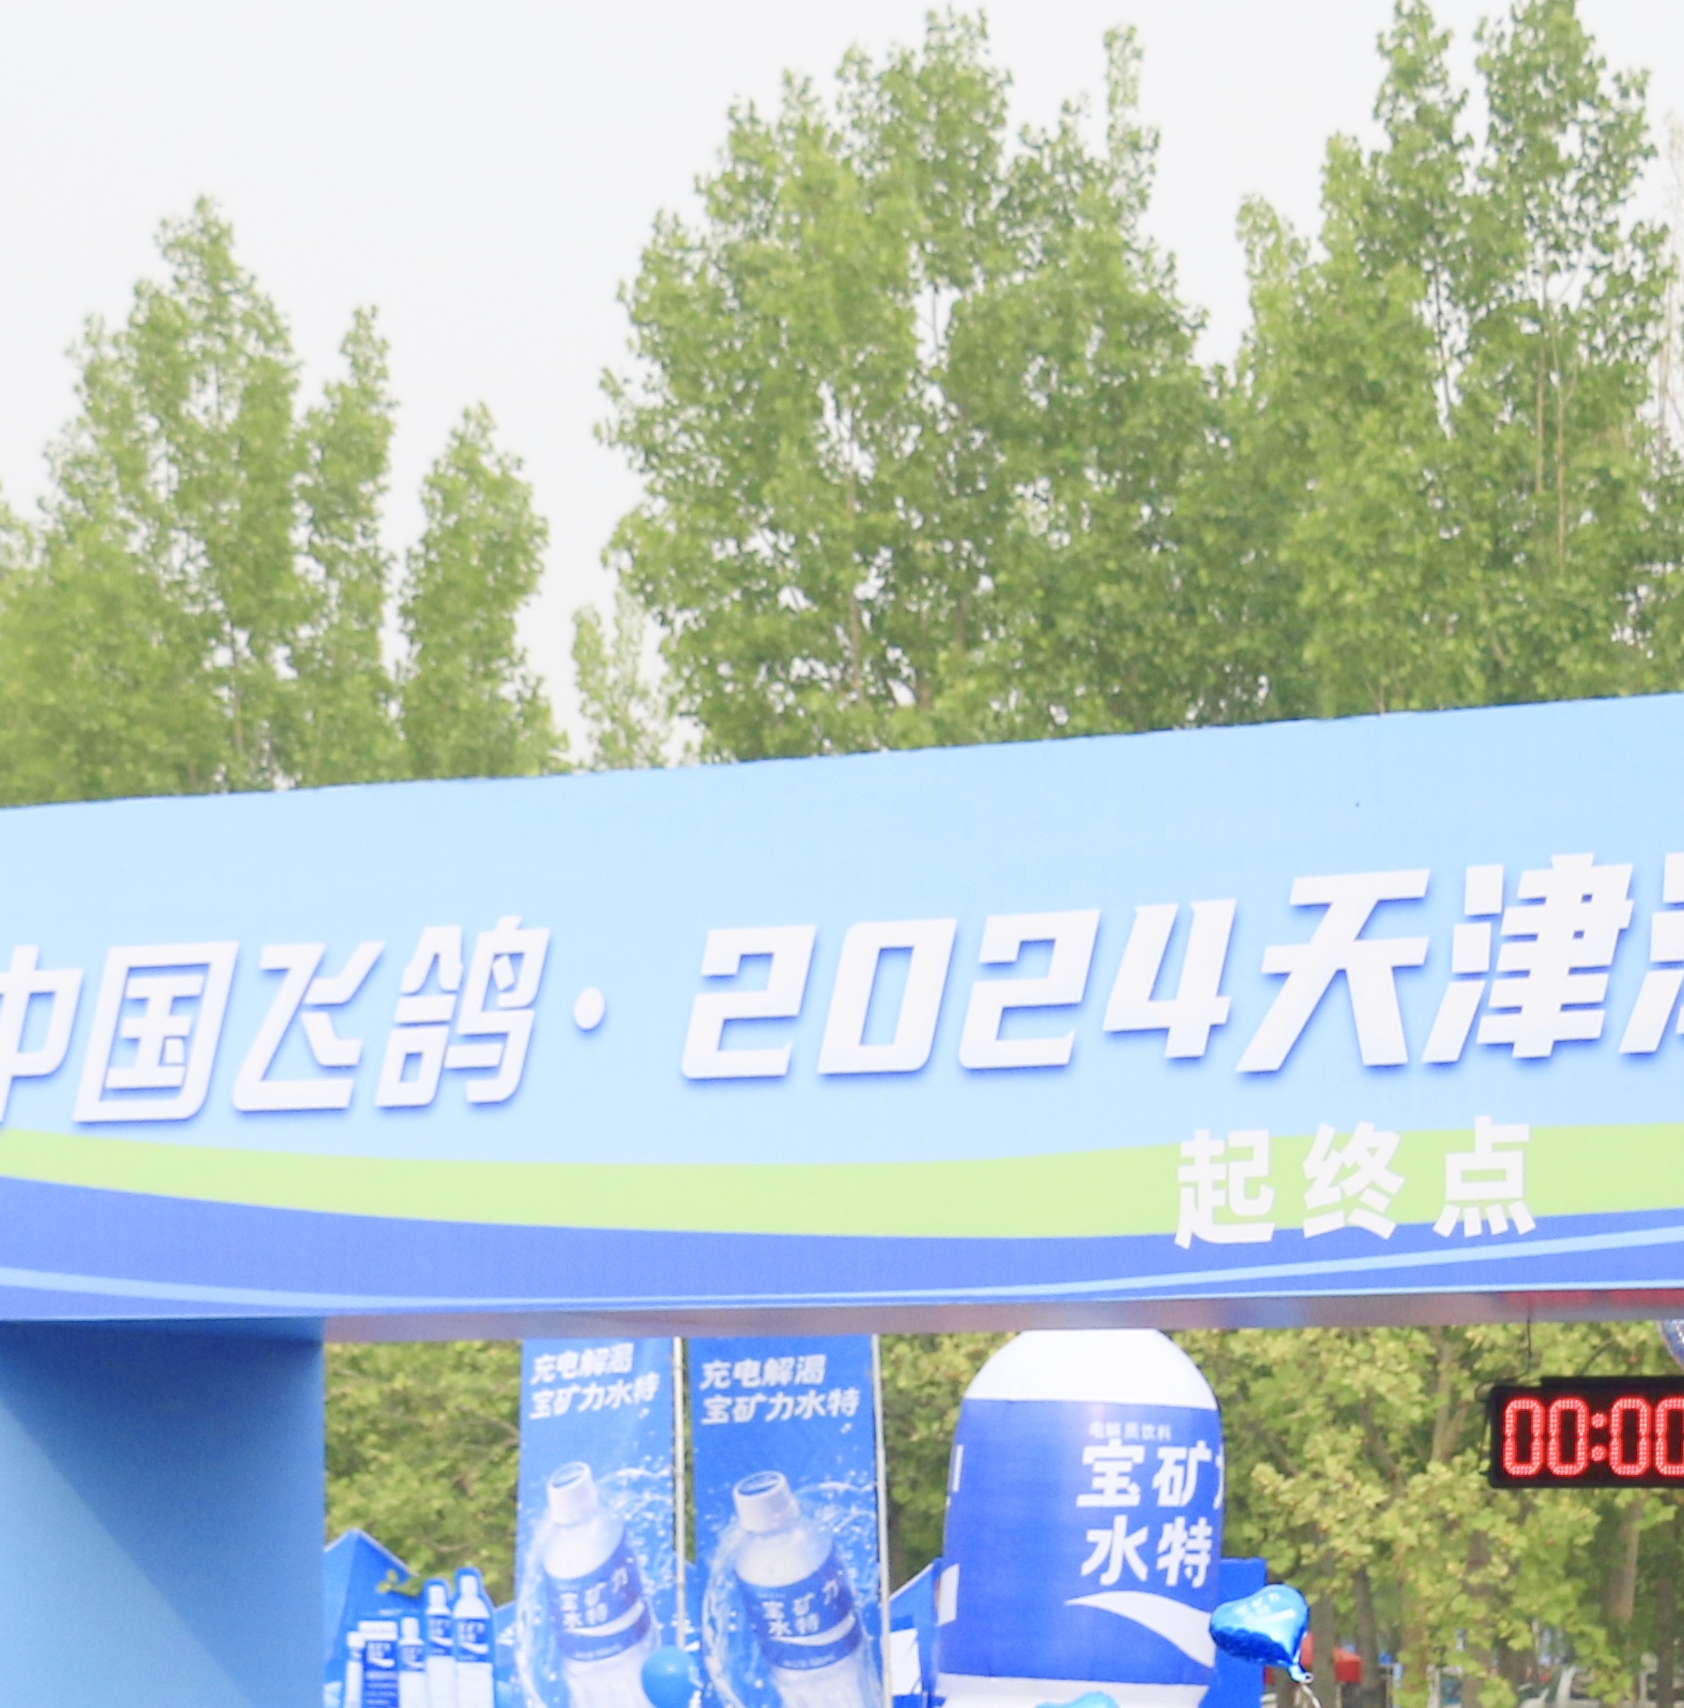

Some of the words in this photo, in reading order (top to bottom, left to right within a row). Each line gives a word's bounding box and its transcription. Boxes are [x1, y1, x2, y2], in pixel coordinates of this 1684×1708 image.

[1175, 1117, 1537, 1250] 起终点
[530, 1341, 634, 1385] 充电解渴
[699, 1353, 827, 1390] 充电解渴
[528, 1371, 660, 1420] 宝矿力水特
[700, 1386, 860, 1425] 宝矿力水特
[1076, 1438, 1225, 1511] 宝矿
[1080, 1514, 1213, 1590] 水特
